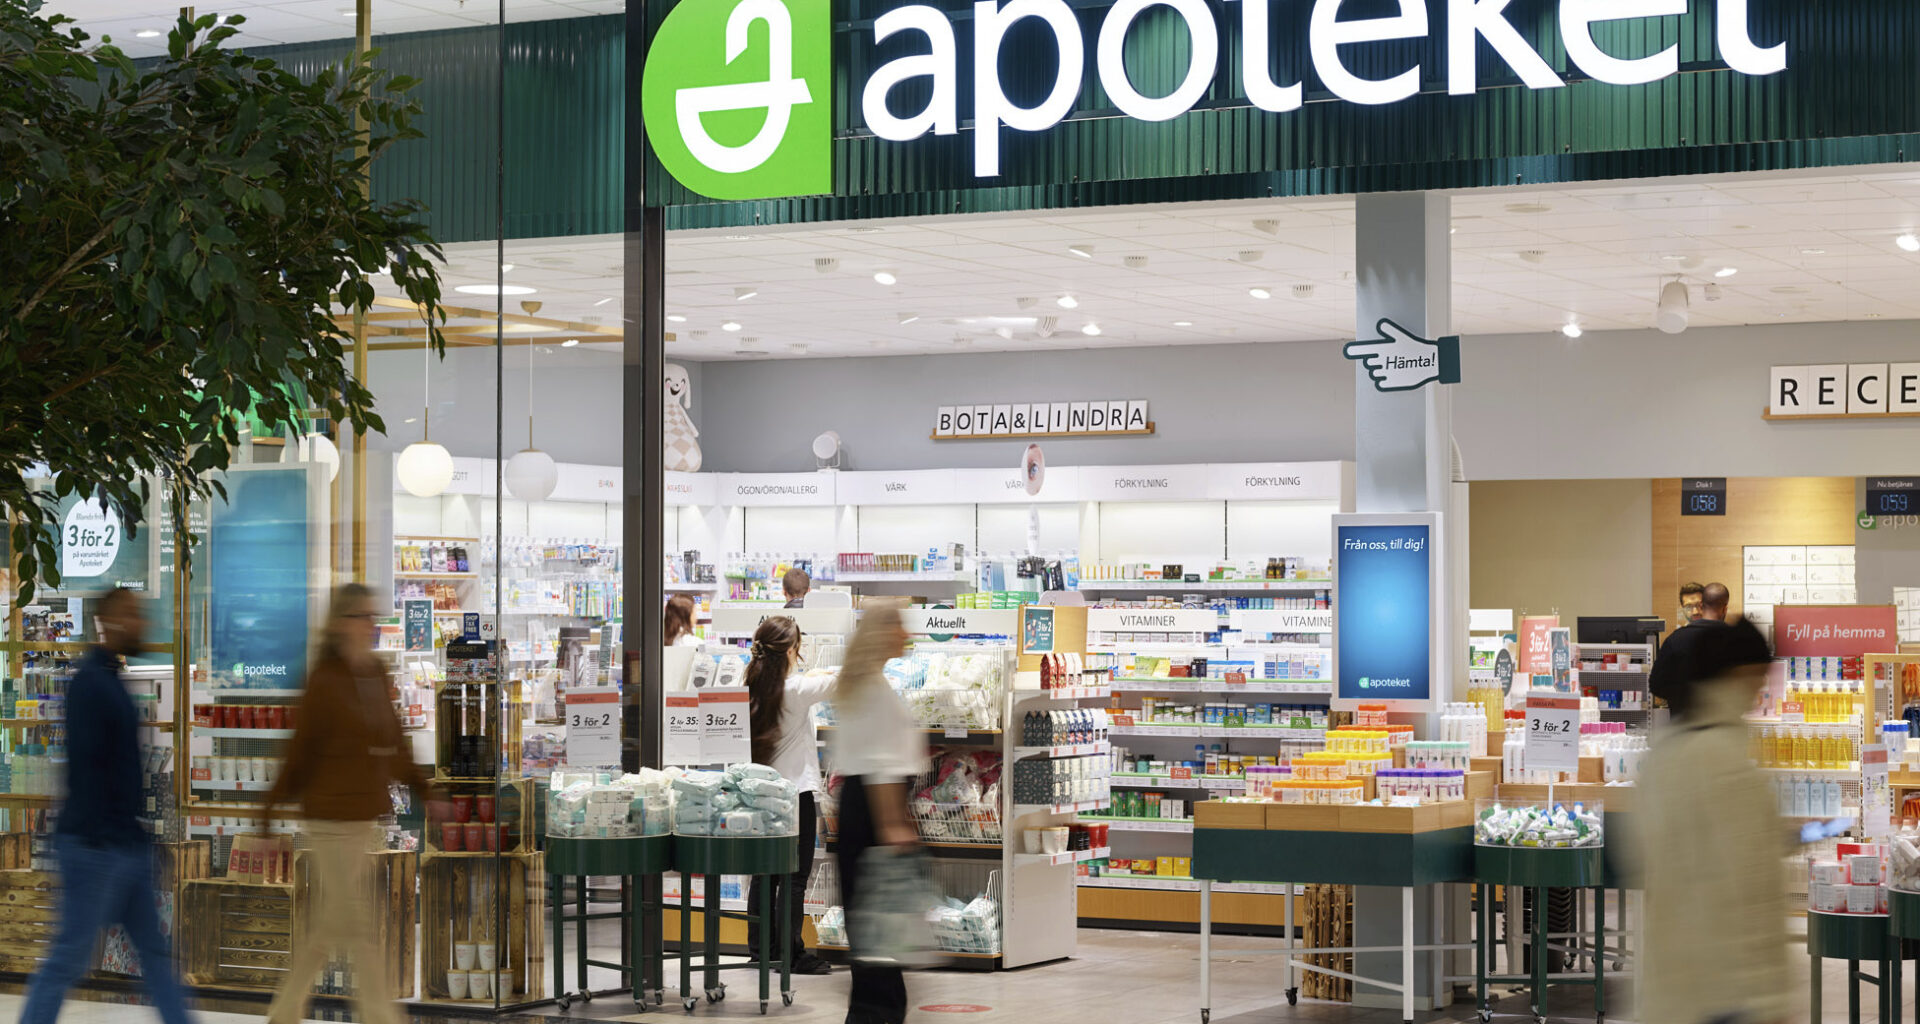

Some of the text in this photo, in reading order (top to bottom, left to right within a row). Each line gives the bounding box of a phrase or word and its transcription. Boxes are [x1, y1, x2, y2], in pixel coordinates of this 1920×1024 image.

[1386, 352, 1436, 370] Hämta!
[1780, 375, 1918, 406] RECE
[885, 481, 907, 492] VÄRK
[1114, 478, 1168, 489] FÖRKYLNING
[1245, 476, 1301, 487] FÖRKYLNING
[737, 484, 818, 495] ÖGON/ÖRON/ALLERGI
[1691, 495, 1717, 511] 058
[1880, 494, 1908, 511] 059
[68, 524, 115, 547] 3 för 2
[1344, 537, 1425, 552] Från oss, till dig!
[409, 609, 429, 618] 3 för 2
[926, 616, 966, 629] Aktuellt
[1037, 621, 1042, 632] 3
[1048, 621, 1052, 632] 2
[1120, 615, 1175, 627] VITAMINER
[1786, 623, 1886, 641] Fyll på hemma
[1529, 630, 1550, 653] 3 för 2
[244, 664, 287, 677] apoteket
[1369, 678, 1411, 688] apoteket
[572, 713, 611, 727] 3 för 2
[670, 716, 676, 726] 2
[706, 713, 738, 726] 3 för 2
[1531, 718, 1570, 732] 3 för 2
[1866, 776, 1871, 790] 3
[1880, 775, 1885, 790] 2
